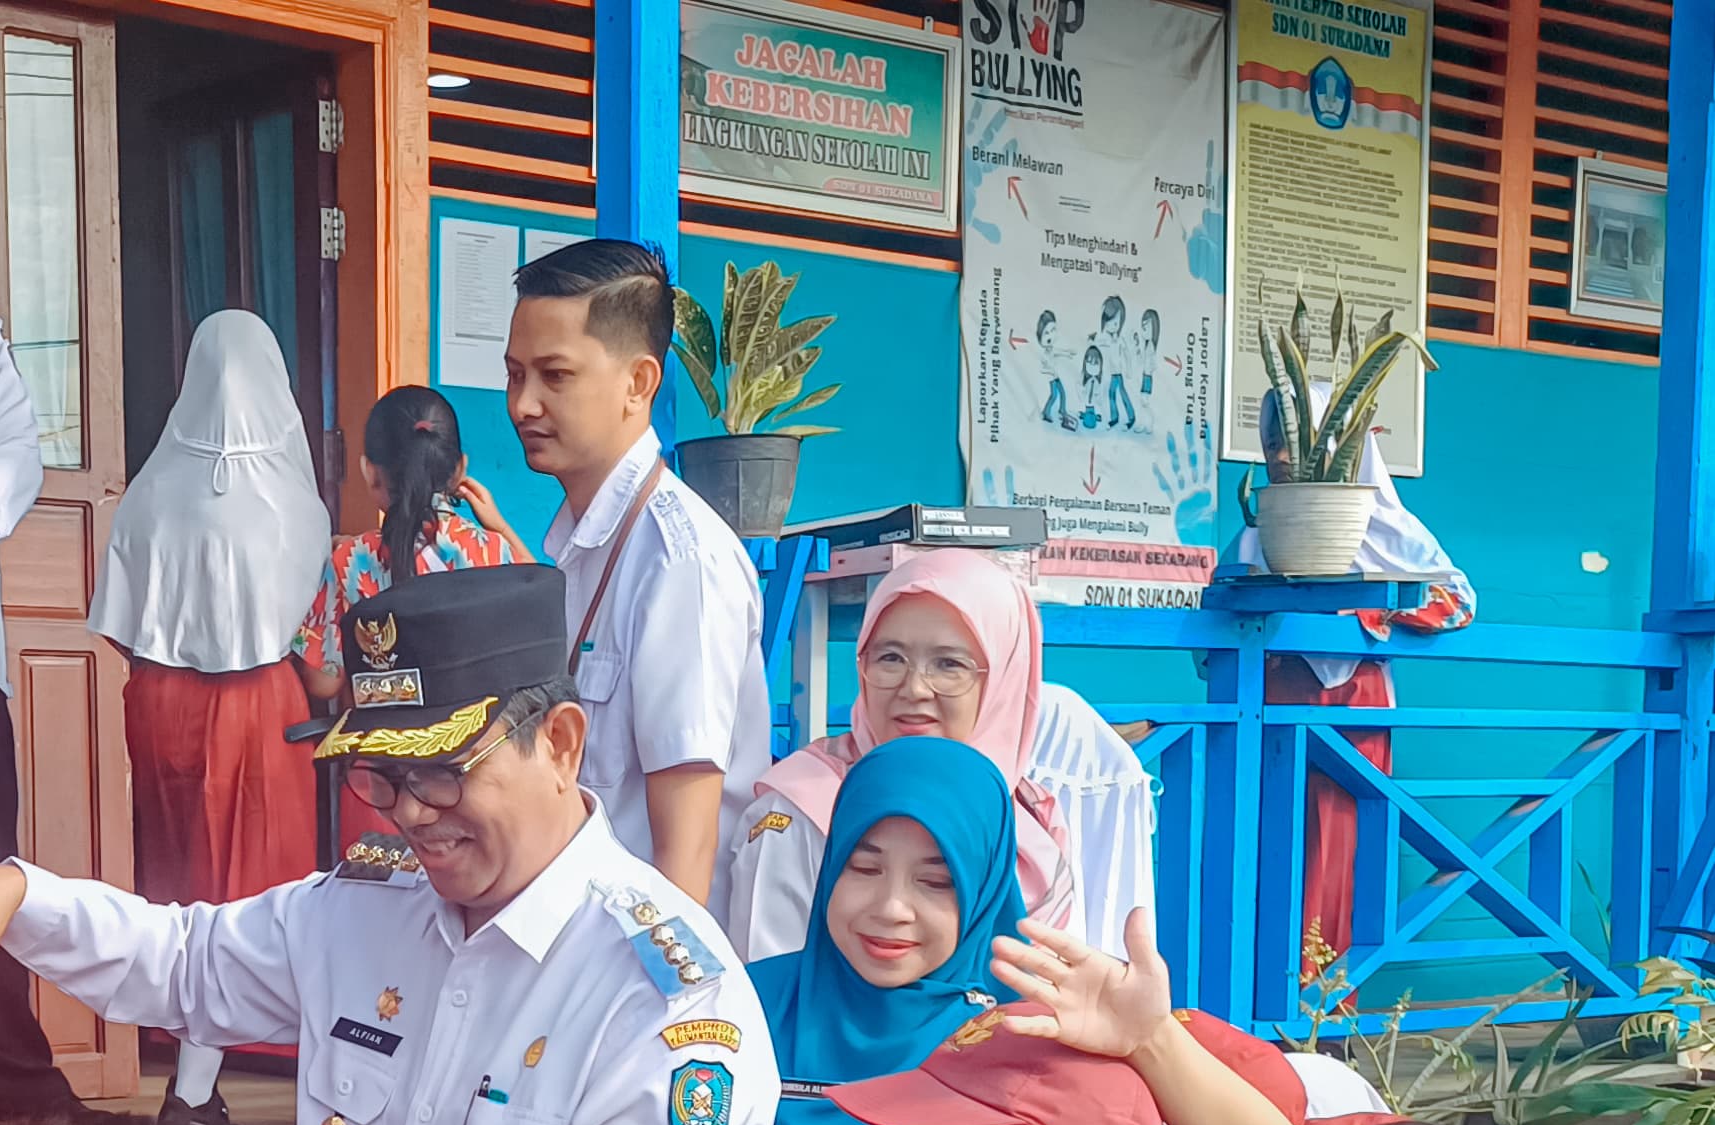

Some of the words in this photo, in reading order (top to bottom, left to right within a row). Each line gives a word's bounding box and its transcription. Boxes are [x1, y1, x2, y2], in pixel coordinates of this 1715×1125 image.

[1272, 12, 1299, 37] SDN
[1302, 19, 1316, 41] 01
[1321, 24, 1391, 58] SUKADANA
[1347, 5, 1406, 36] SEKOLAH
[737, 34, 886, 91] JAGALAH
[971, 48, 1083, 107] BULLYING
[705, 70, 913, 137] KEBERSIHAN
[683, 112, 809, 162] LINGKUNGAN
[812, 130, 899, 175] SEKOLAH
[902, 148, 931, 180] INI
[972, 146, 1009, 167] Berani
[1012, 152, 1063, 176] Melawan
[1154, 176, 1195, 200] Percaya
[1045, 229, 1065, 248] Tips
[1068, 232, 1128, 255] Menghindari
[1131, 243, 1138, 256] &
[1041, 253, 1093, 273] Mengatasi
[979, 289, 990, 347] Kepada
[991, 267, 1002, 354] Berwenang
[1185, 332, 1196, 388] Orang
[1199, 316, 1210, 369] Lapor
[977, 351, 989, 424] Laporkan
[991, 359, 1002, 397] Yang
[990, 401, 999, 443] Pihak
[1185, 393, 1196, 425] Tua
[1013, 493, 1046, 507] Berbagi
[1049, 495, 1103, 511] Pengalaman
[1104, 499, 1141, 513] Bersama
[1143, 502, 1171, 515] Teman
[1079, 518, 1127, 534] Mengalami
[1128, 521, 1149, 537] Bully
[1070, 547, 1143, 565] KEKERASAN
[1145, 551, 1208, 569] SEKARANG
[1084, 584, 1115, 607] SDN
[1118, 587, 1132, 608] 01
[349, 1027, 383, 1045] ALFIAN
